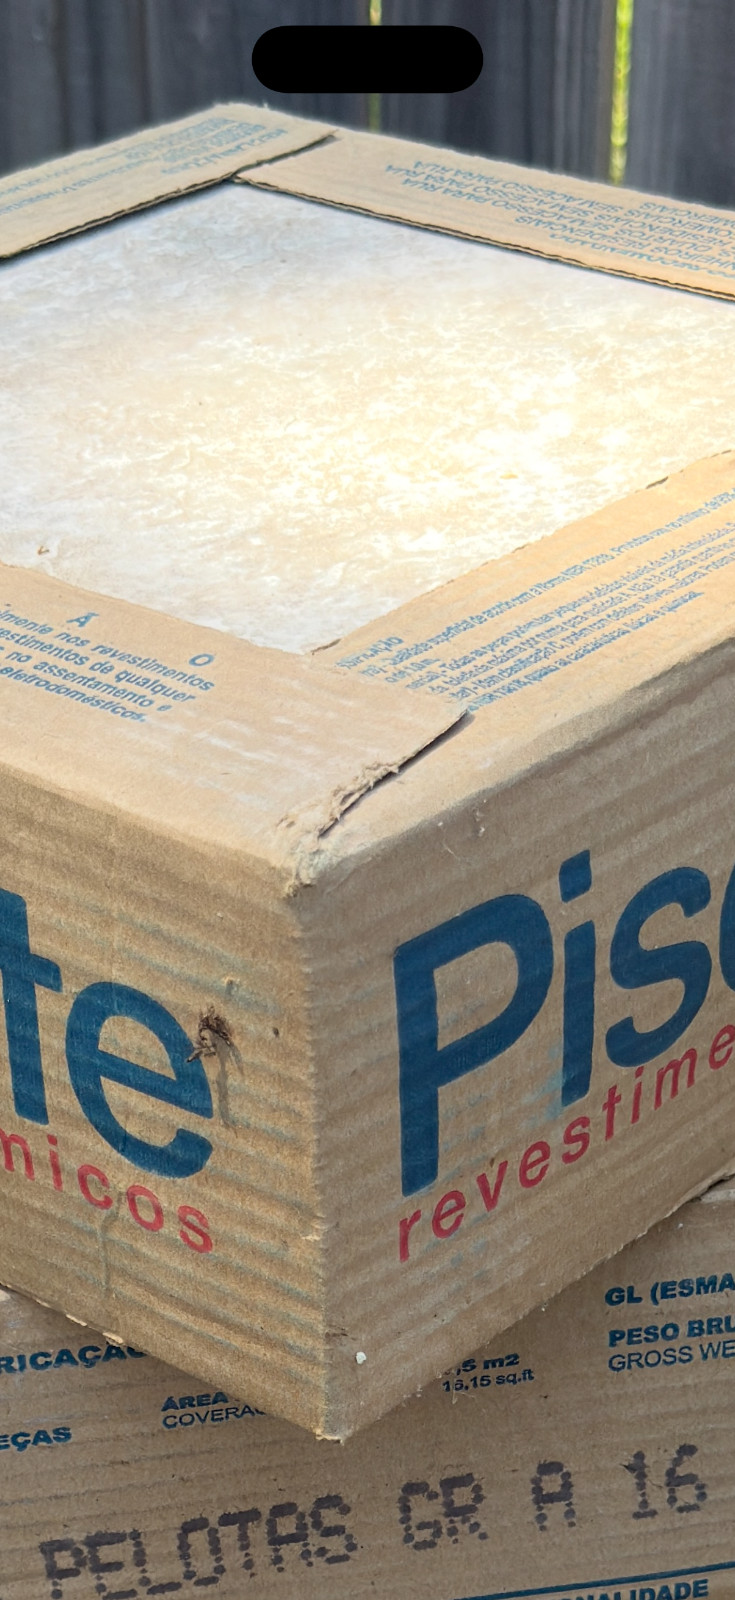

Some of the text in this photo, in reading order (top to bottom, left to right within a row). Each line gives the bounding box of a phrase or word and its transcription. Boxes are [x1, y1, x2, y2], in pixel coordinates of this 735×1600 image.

[0, 627, 196, 702] estimentos de qualquer
[54, 631, 90, 647] nos
[91, 645, 215, 691] revestimentos
[5, 651, 33, 662] no
[33, 661, 155, 707] assentamento
[0, 888, 214, 1180] te
[605, 1272, 735, 1306] GL (ESMA
[608, 1322, 680, 1348] PESO
[483, 1353, 519, 1370] m2
[608, 1339, 735, 1372] GROSS WE
[495, 1368, 535, 1386] sq.ft
[161, 1391, 229, 1412] ÁREA
[162, 1404, 266, 1430] COVERA
[39, 1443, 708, 1600] PELOTAS GR A 16
